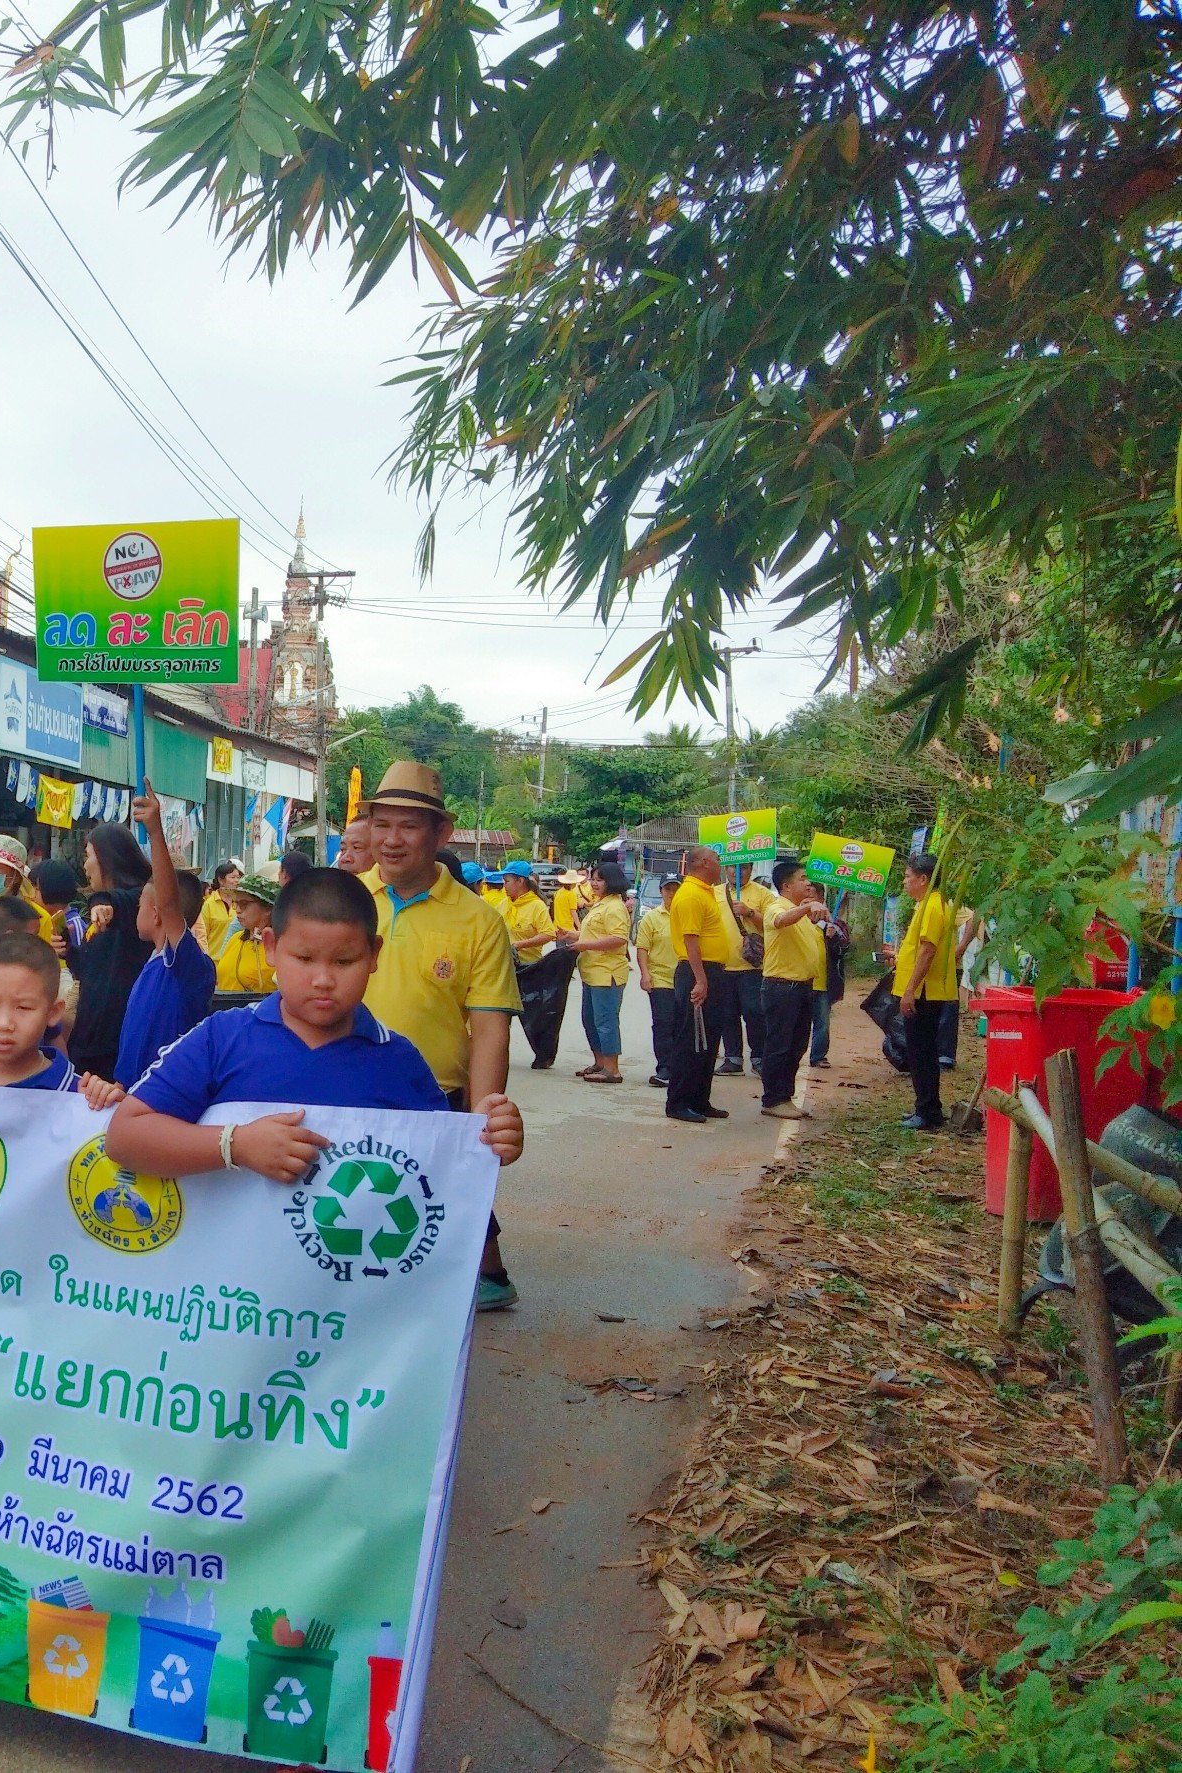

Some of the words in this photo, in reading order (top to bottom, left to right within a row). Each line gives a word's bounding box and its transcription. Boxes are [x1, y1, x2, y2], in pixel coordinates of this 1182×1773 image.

[44, 611, 97, 647] ลด
[107, 612, 151, 647] ละ
[162, 598, 230, 647] เลิก
[57, 652, 221, 679] การใช้โฟมบรรจุอาหาร
[726, 841, 744, 853] ละ
[747, 834, 773, 850] เลิก
[810, 858, 833, 873] ลด
[836, 864, 855, 877] ละ
[857, 866, 884, 884] เลิก
[319, 1135, 420, 1175] Reduce
[283, 1190, 354, 1282] Recycle
[397, 1203, 445, 1275] Reuse
[48, 1253, 347, 1343] ในแผนปฏิบัติการ
[28, 1437, 131, 1499] มีนาคม
[151, 1476, 244, 1520] 2562
[38, 1579, 63, 1596] NEWS
